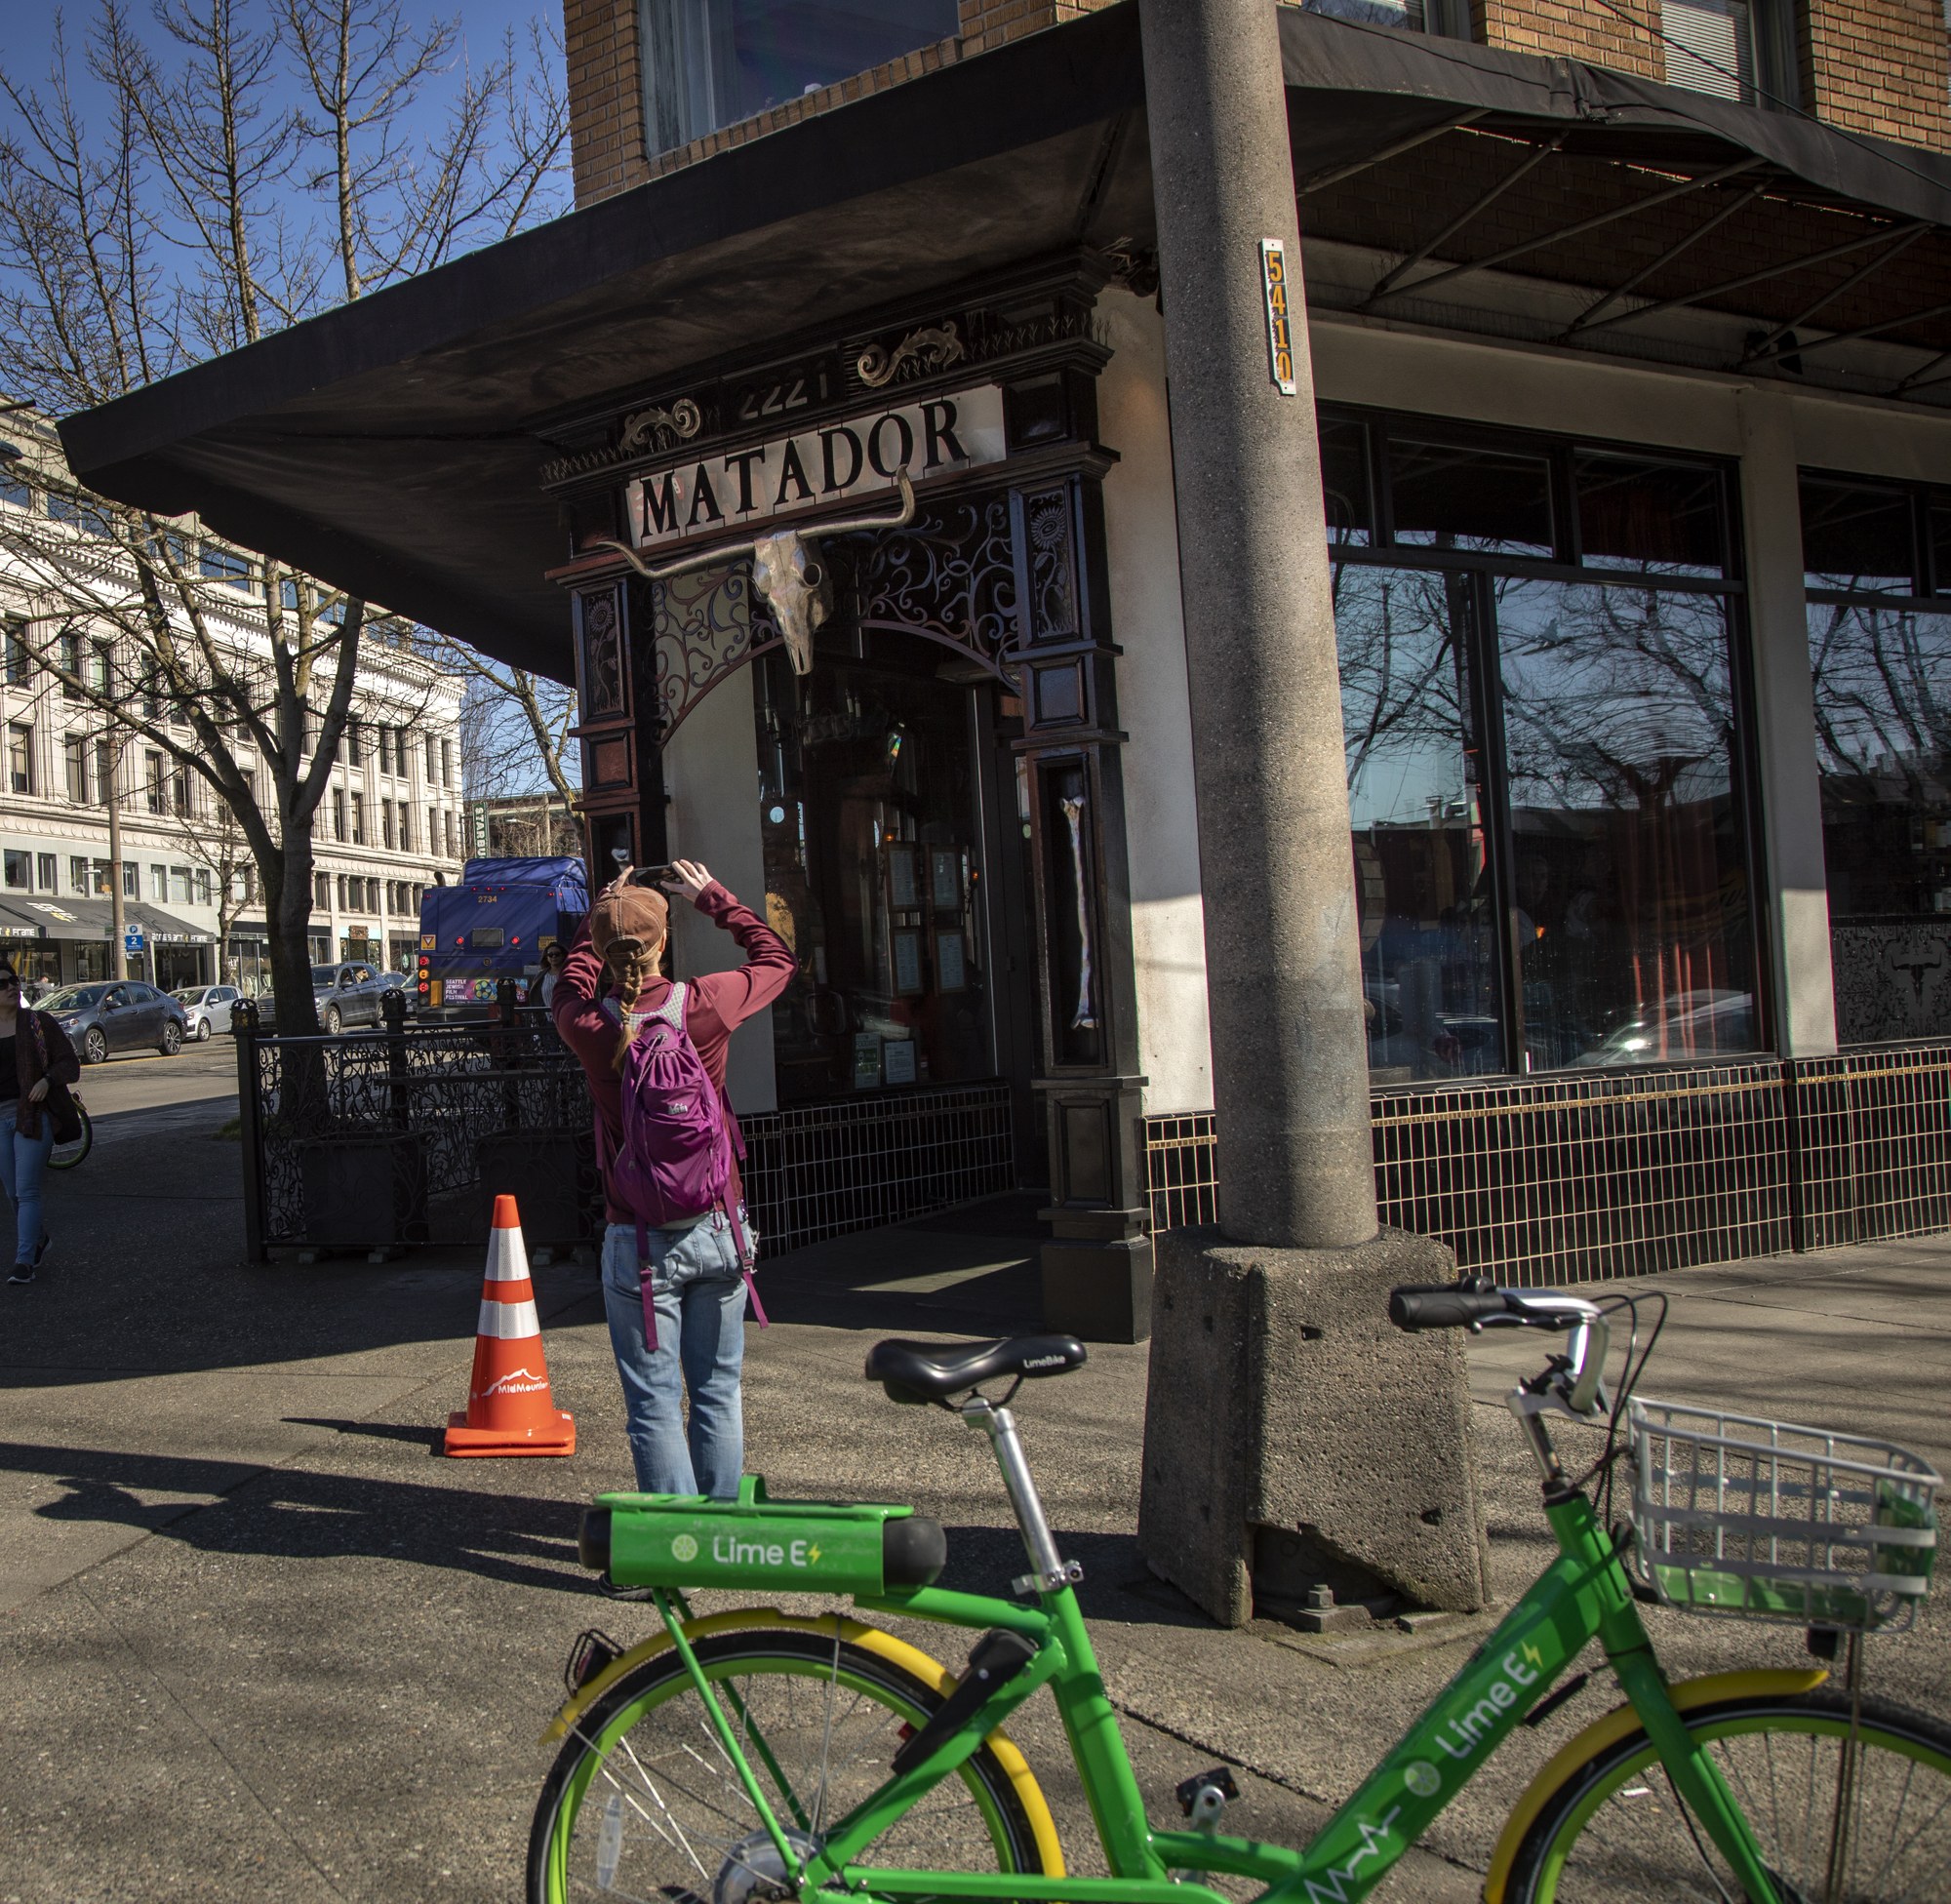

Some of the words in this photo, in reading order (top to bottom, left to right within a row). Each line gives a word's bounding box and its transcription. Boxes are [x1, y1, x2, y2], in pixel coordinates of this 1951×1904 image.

[1268, 252, 1292, 382] 5410
[640, 400, 971, 537] MATADOR
[474, 807, 487, 858] STARBU
[131, 936, 138, 945] 2
[1023, 1355, 1066, 1368] LimeBike
[713, 1536, 784, 1566] Lime
[789, 1539, 808, 1567] E
[1434, 1679, 1518, 1759] Lime
[1501, 1651, 1539, 1686] E
